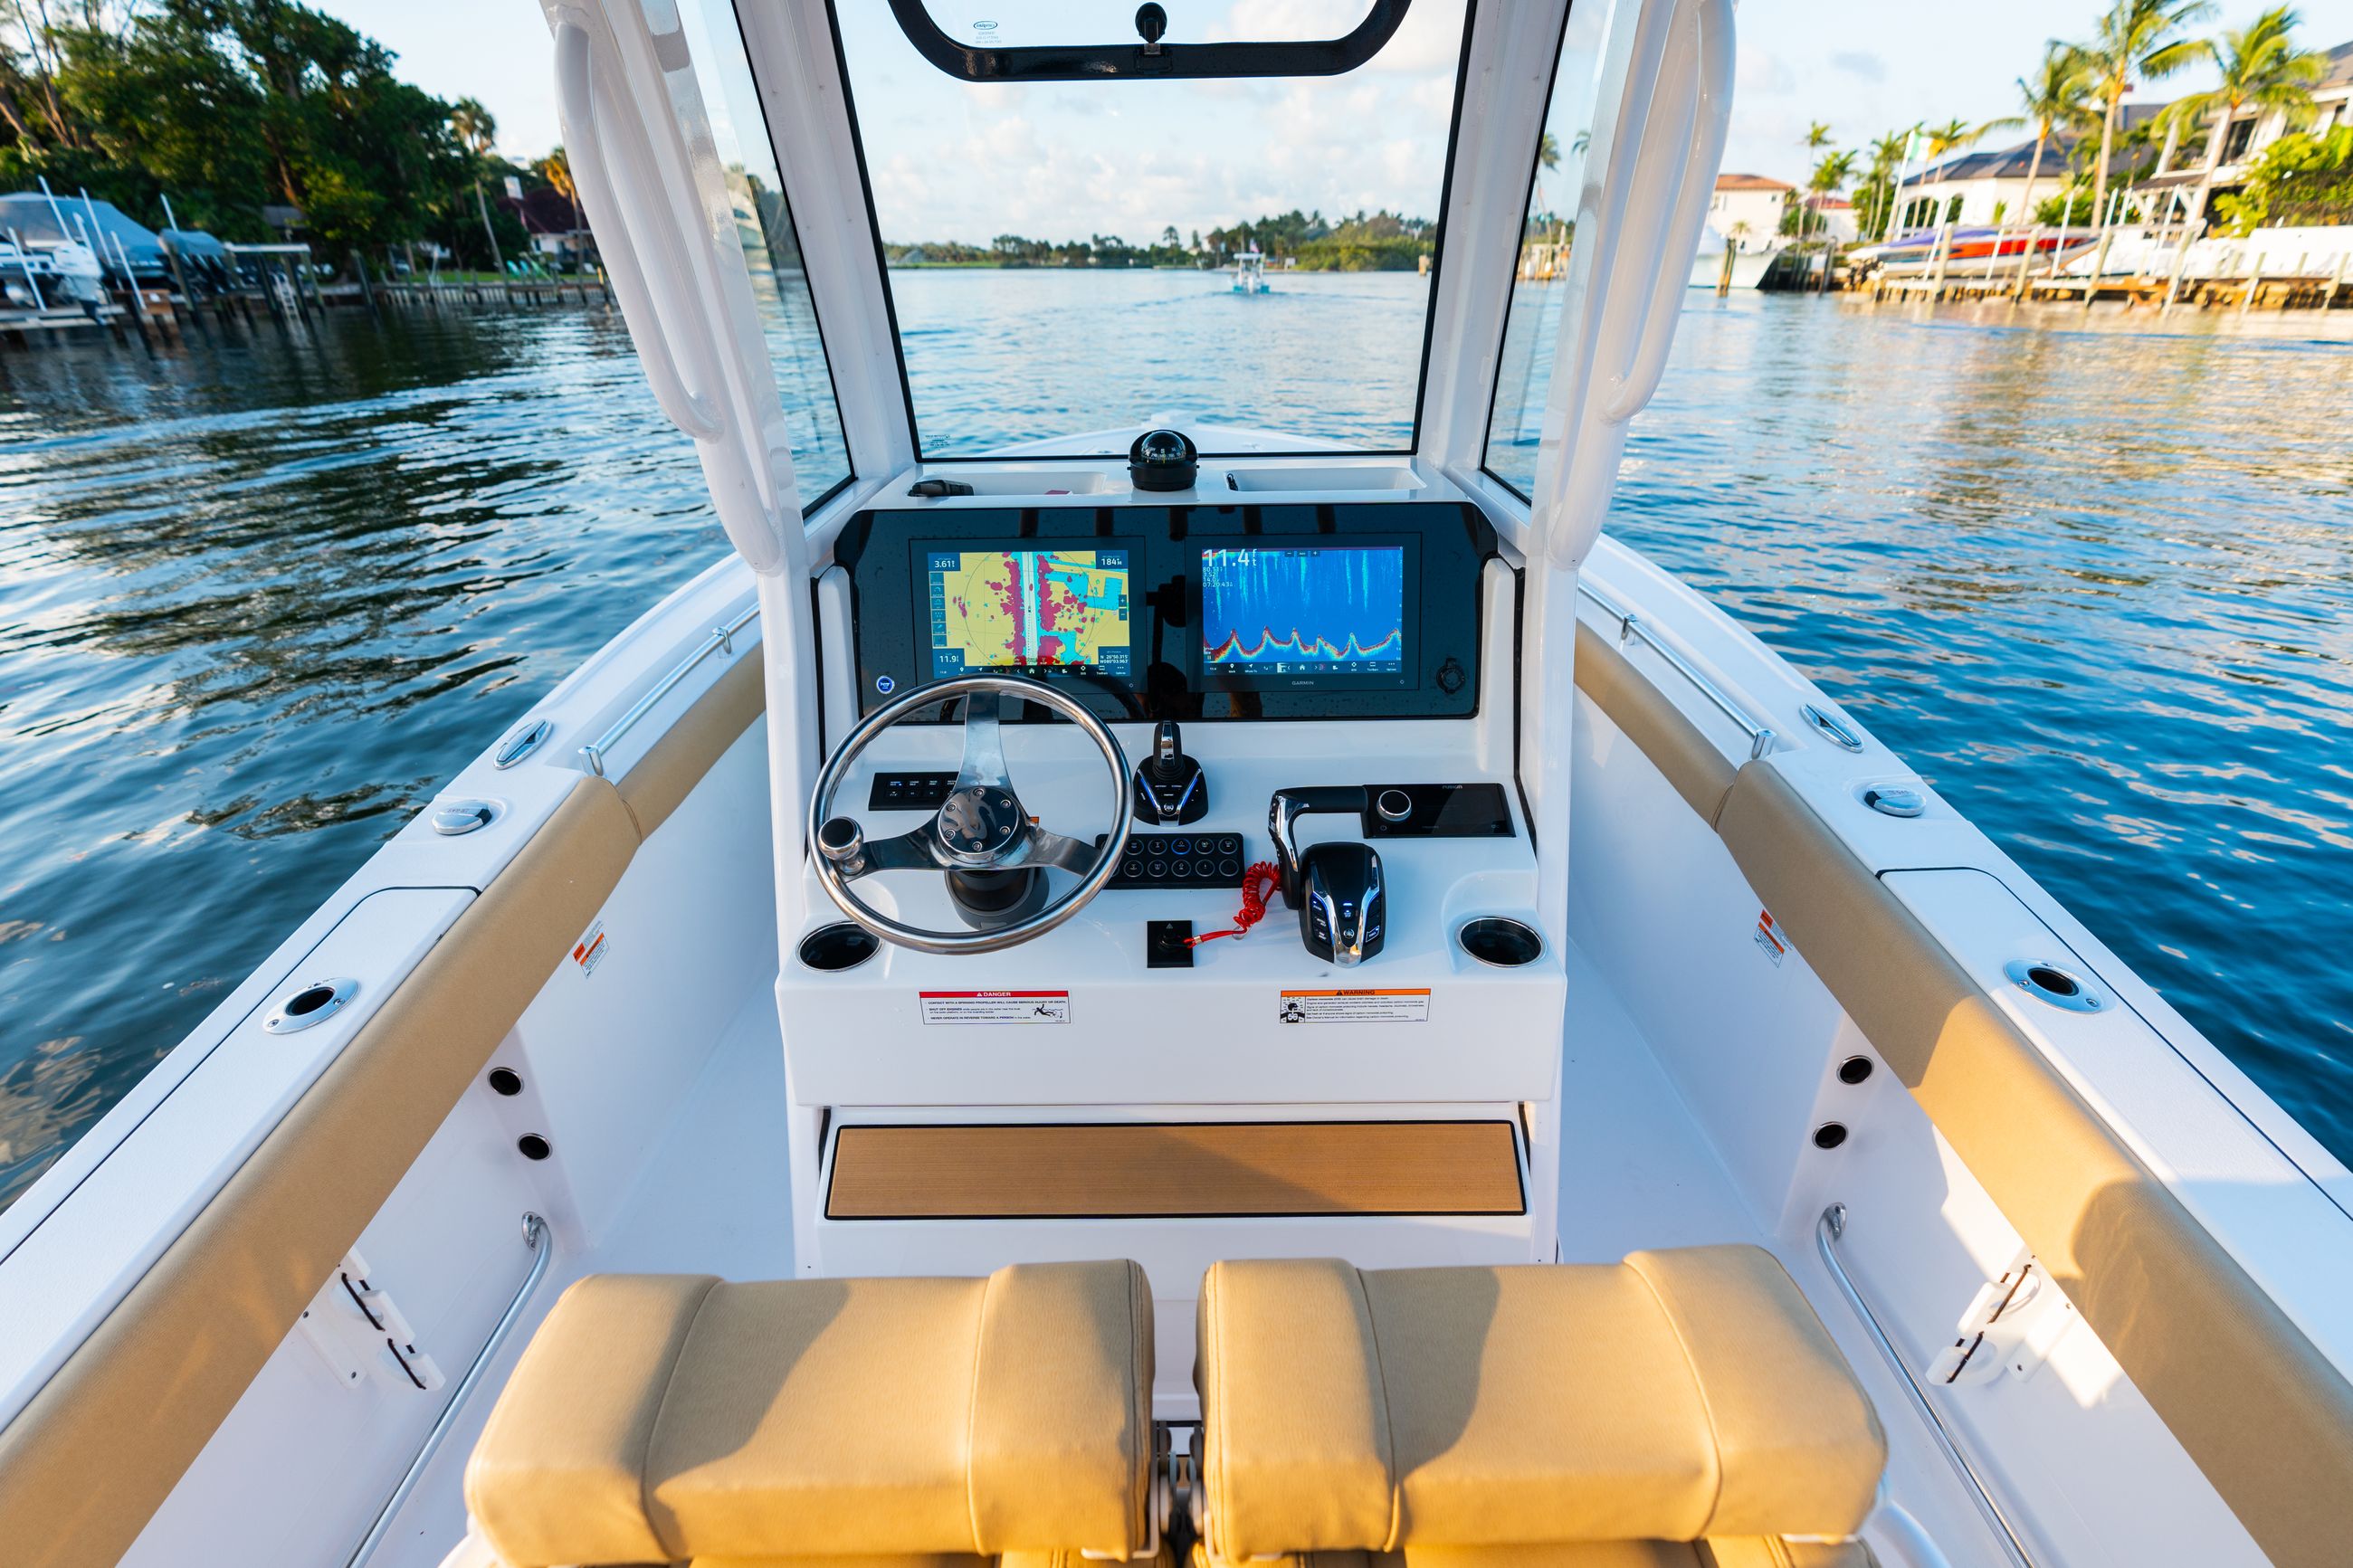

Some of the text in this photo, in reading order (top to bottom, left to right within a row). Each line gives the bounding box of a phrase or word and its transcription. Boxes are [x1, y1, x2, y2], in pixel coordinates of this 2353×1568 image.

[1100, 557, 1117, 565] 184
[1204, 548, 1250, 566] 11.4
[934, 560, 951, 568] 3.61
[938, 655, 957, 663] 11.9
